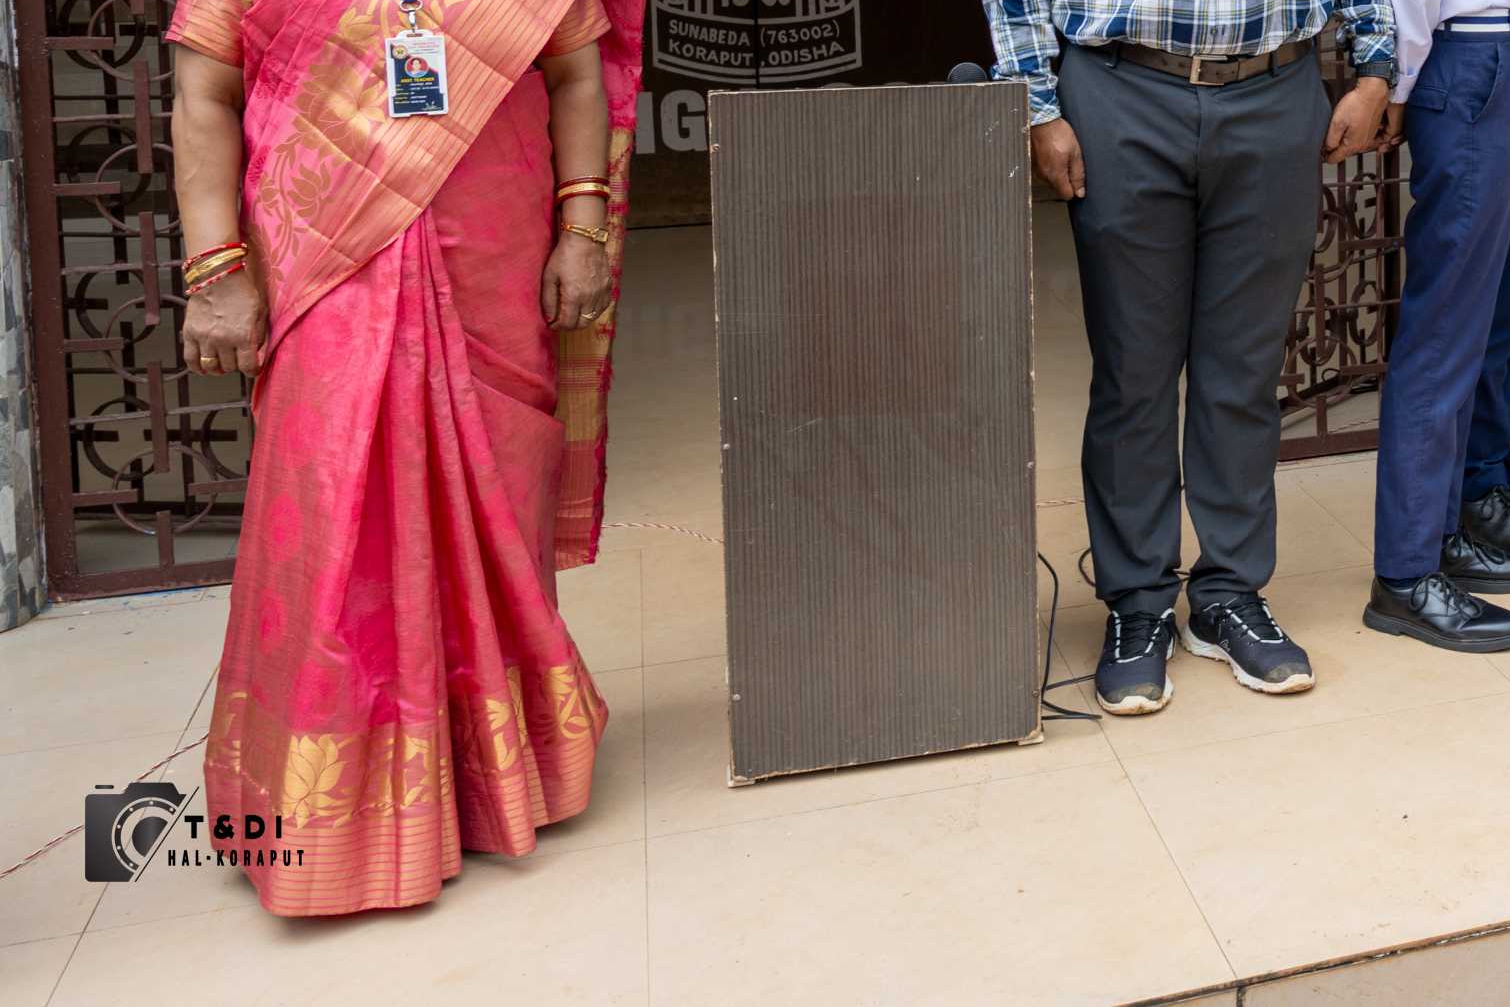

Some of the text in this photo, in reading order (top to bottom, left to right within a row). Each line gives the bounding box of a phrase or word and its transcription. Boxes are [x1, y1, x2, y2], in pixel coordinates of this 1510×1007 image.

[668, 19, 840, 47] SUNABEDA (763002)
[668, 39, 754, 66] KORAPUT
[635, 90, 708, 154] IG
